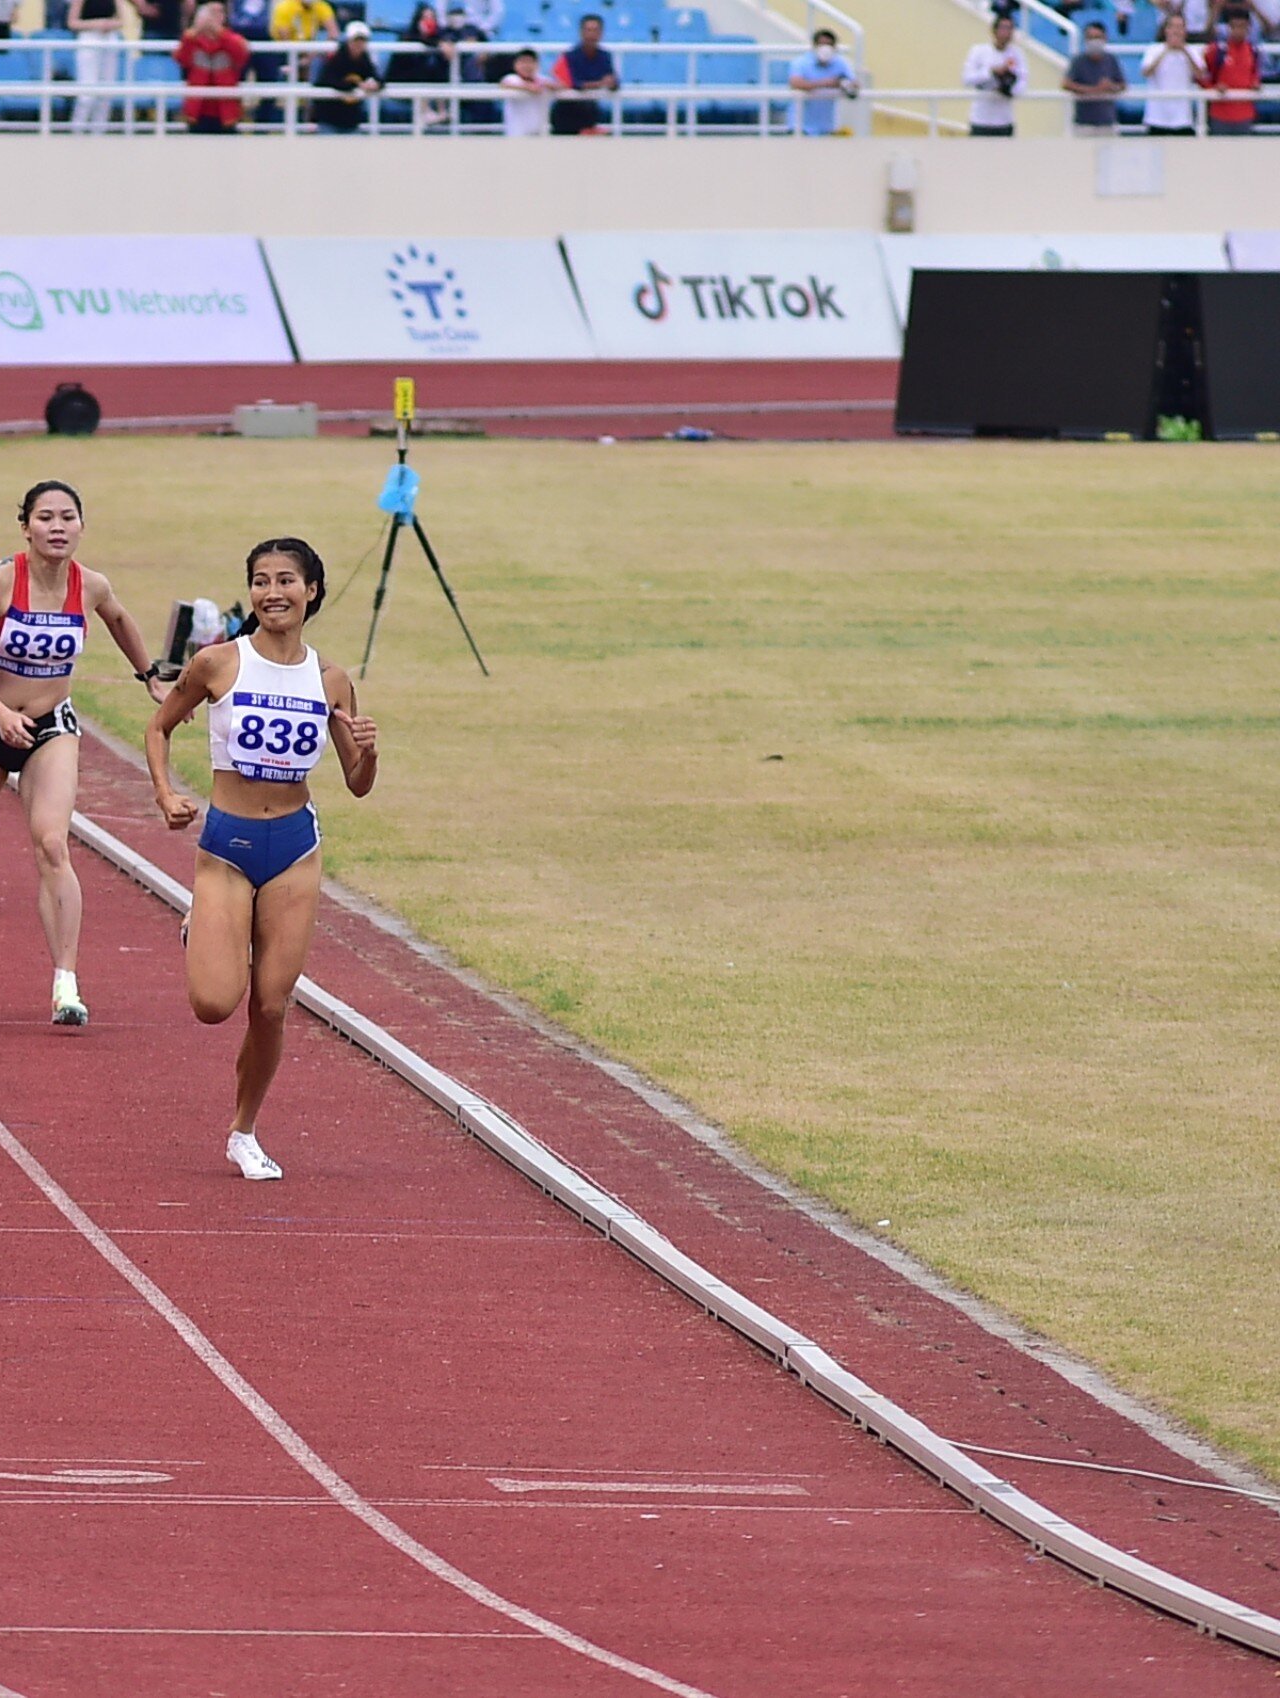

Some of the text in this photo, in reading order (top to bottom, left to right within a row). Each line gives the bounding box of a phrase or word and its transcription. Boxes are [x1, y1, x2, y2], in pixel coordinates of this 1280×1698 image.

[47, 287, 248, 315] TVU Networks
[680, 274, 846, 319] TikTok
[5, 629, 76, 660] 839
[267, 695, 285, 709] SEA
[286, 697, 314, 712] Games
[237, 714, 319, 757] 838
